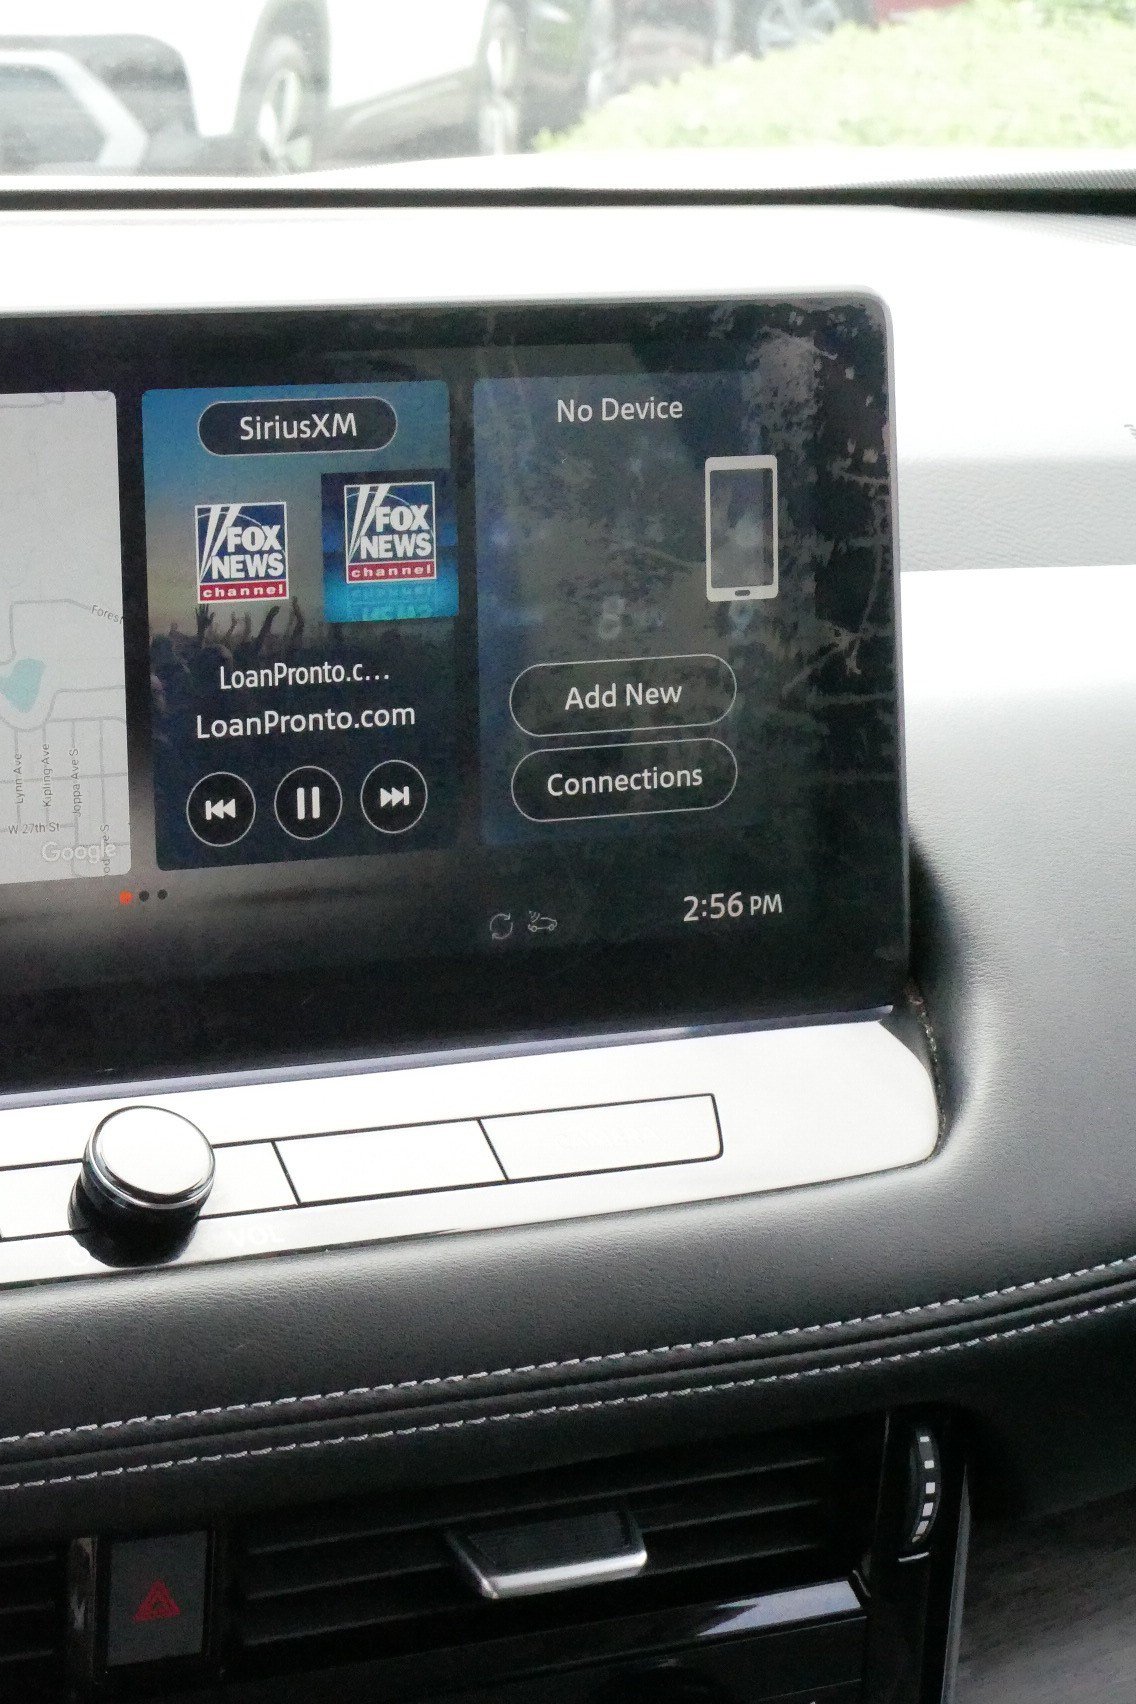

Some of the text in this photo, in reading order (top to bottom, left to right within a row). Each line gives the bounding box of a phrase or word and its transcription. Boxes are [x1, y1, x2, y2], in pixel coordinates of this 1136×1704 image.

[557, 396, 684, 423] No Device
[239, 412, 358, 441] SiriusXM
[374, 504, 431, 533] FOX
[227, 525, 282, 553] FOX
[360, 532, 432, 560] NEWS
[211, 554, 285, 580] NEWS
[351, 564, 432, 578] channel
[202, 583, 285, 599] channel
[219, 661, 391, 690] LoanPronto.c...
[564, 682, 683, 711] Add New
[196, 706, 416, 739] LoanPronto.com
[13, 753, 26, 804] Lynn Ave
[41, 743, 54, 808] Kipling Ave
[69, 748, 83, 818] Joppa Ave S
[546, 766, 704, 798] Connections
[8, 821, 60, 835] W 27th St
[41, 839, 117, 864] Google
[683, 891, 784, 922] 2:56 PM
